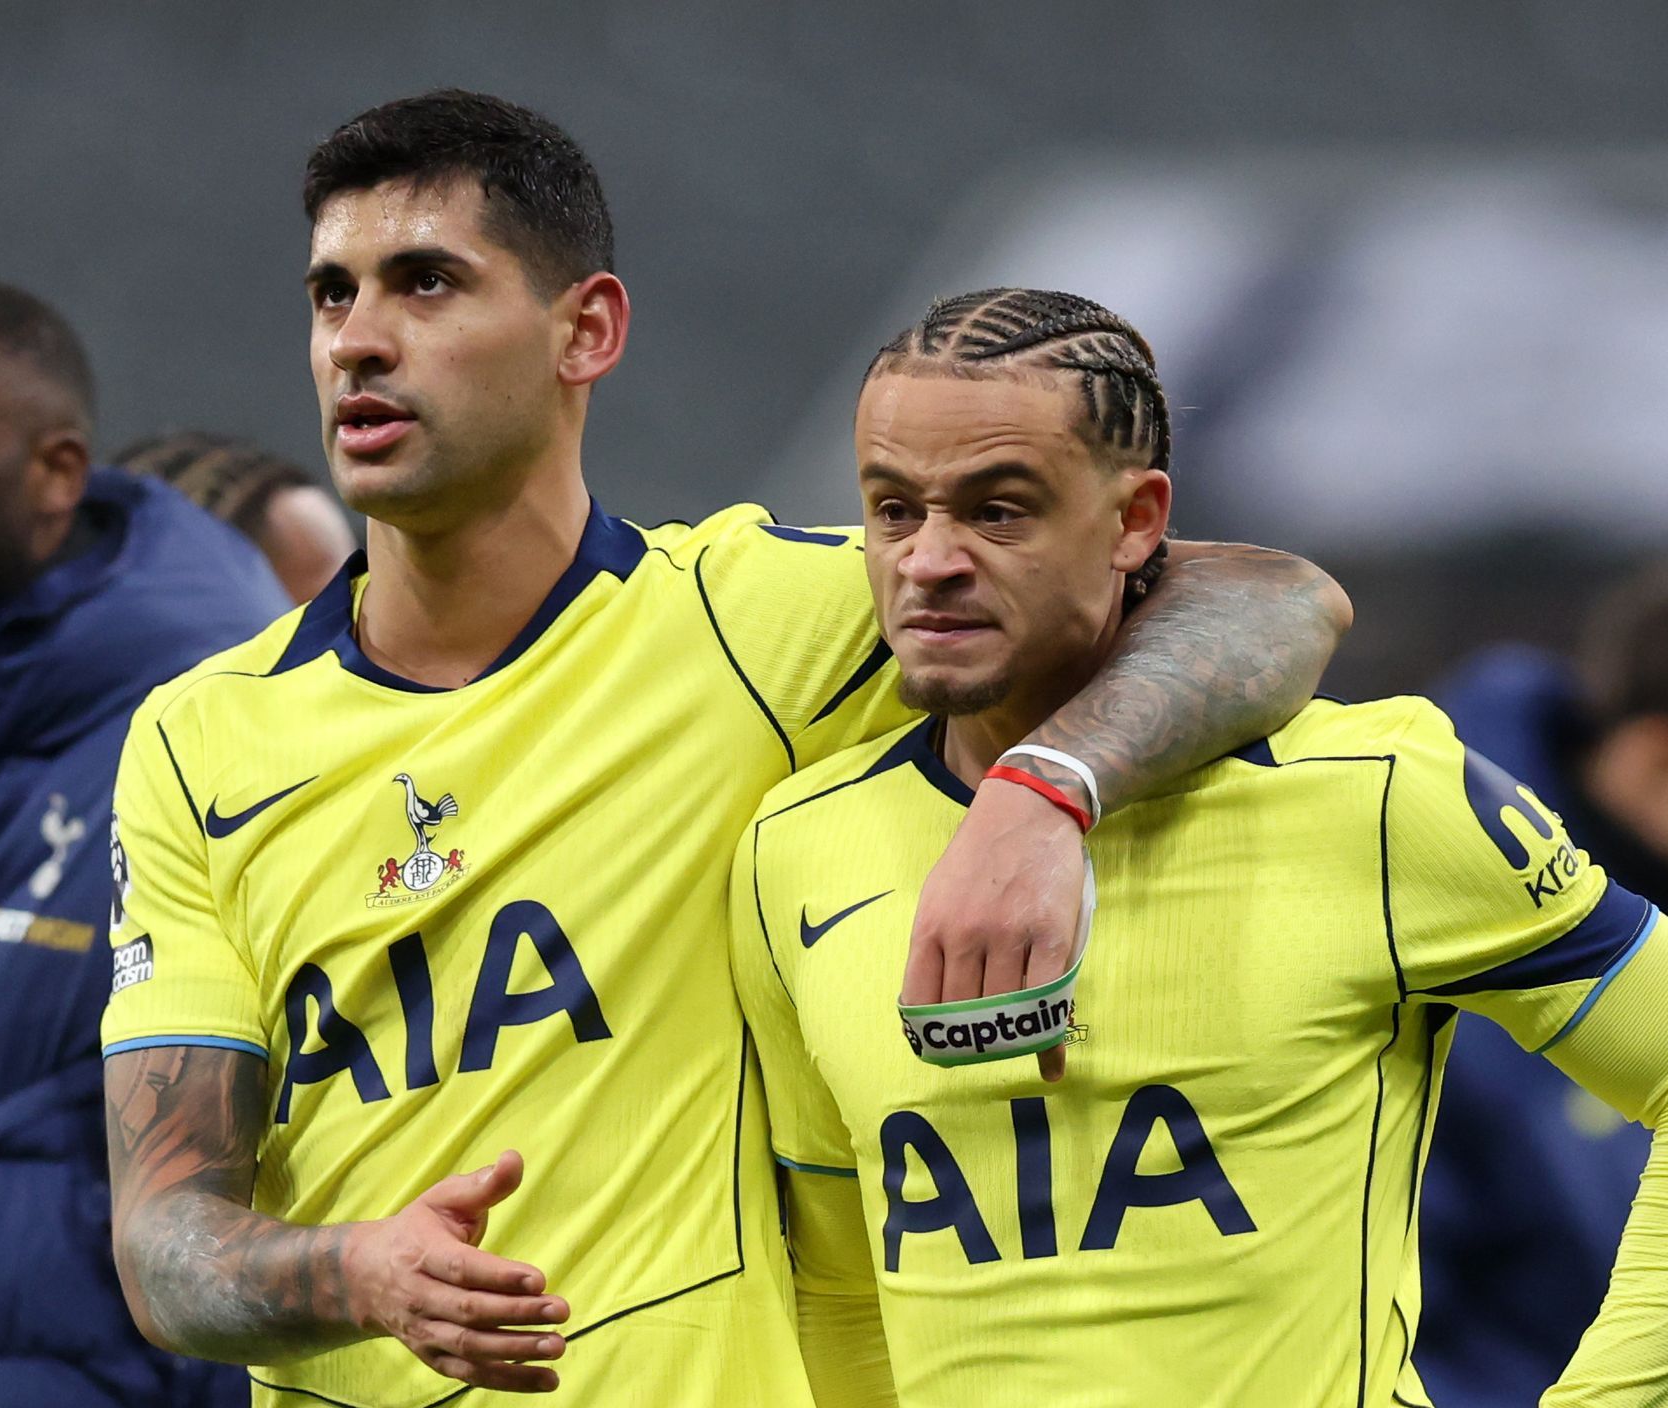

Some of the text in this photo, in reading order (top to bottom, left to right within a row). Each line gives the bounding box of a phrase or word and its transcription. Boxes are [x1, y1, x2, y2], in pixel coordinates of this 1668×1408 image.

[113, 941, 147, 971] oom
[275, 899, 612, 1123] AIA
[923, 999, 1069, 1053] Captain
[880, 1084, 1257, 1273] AIA
